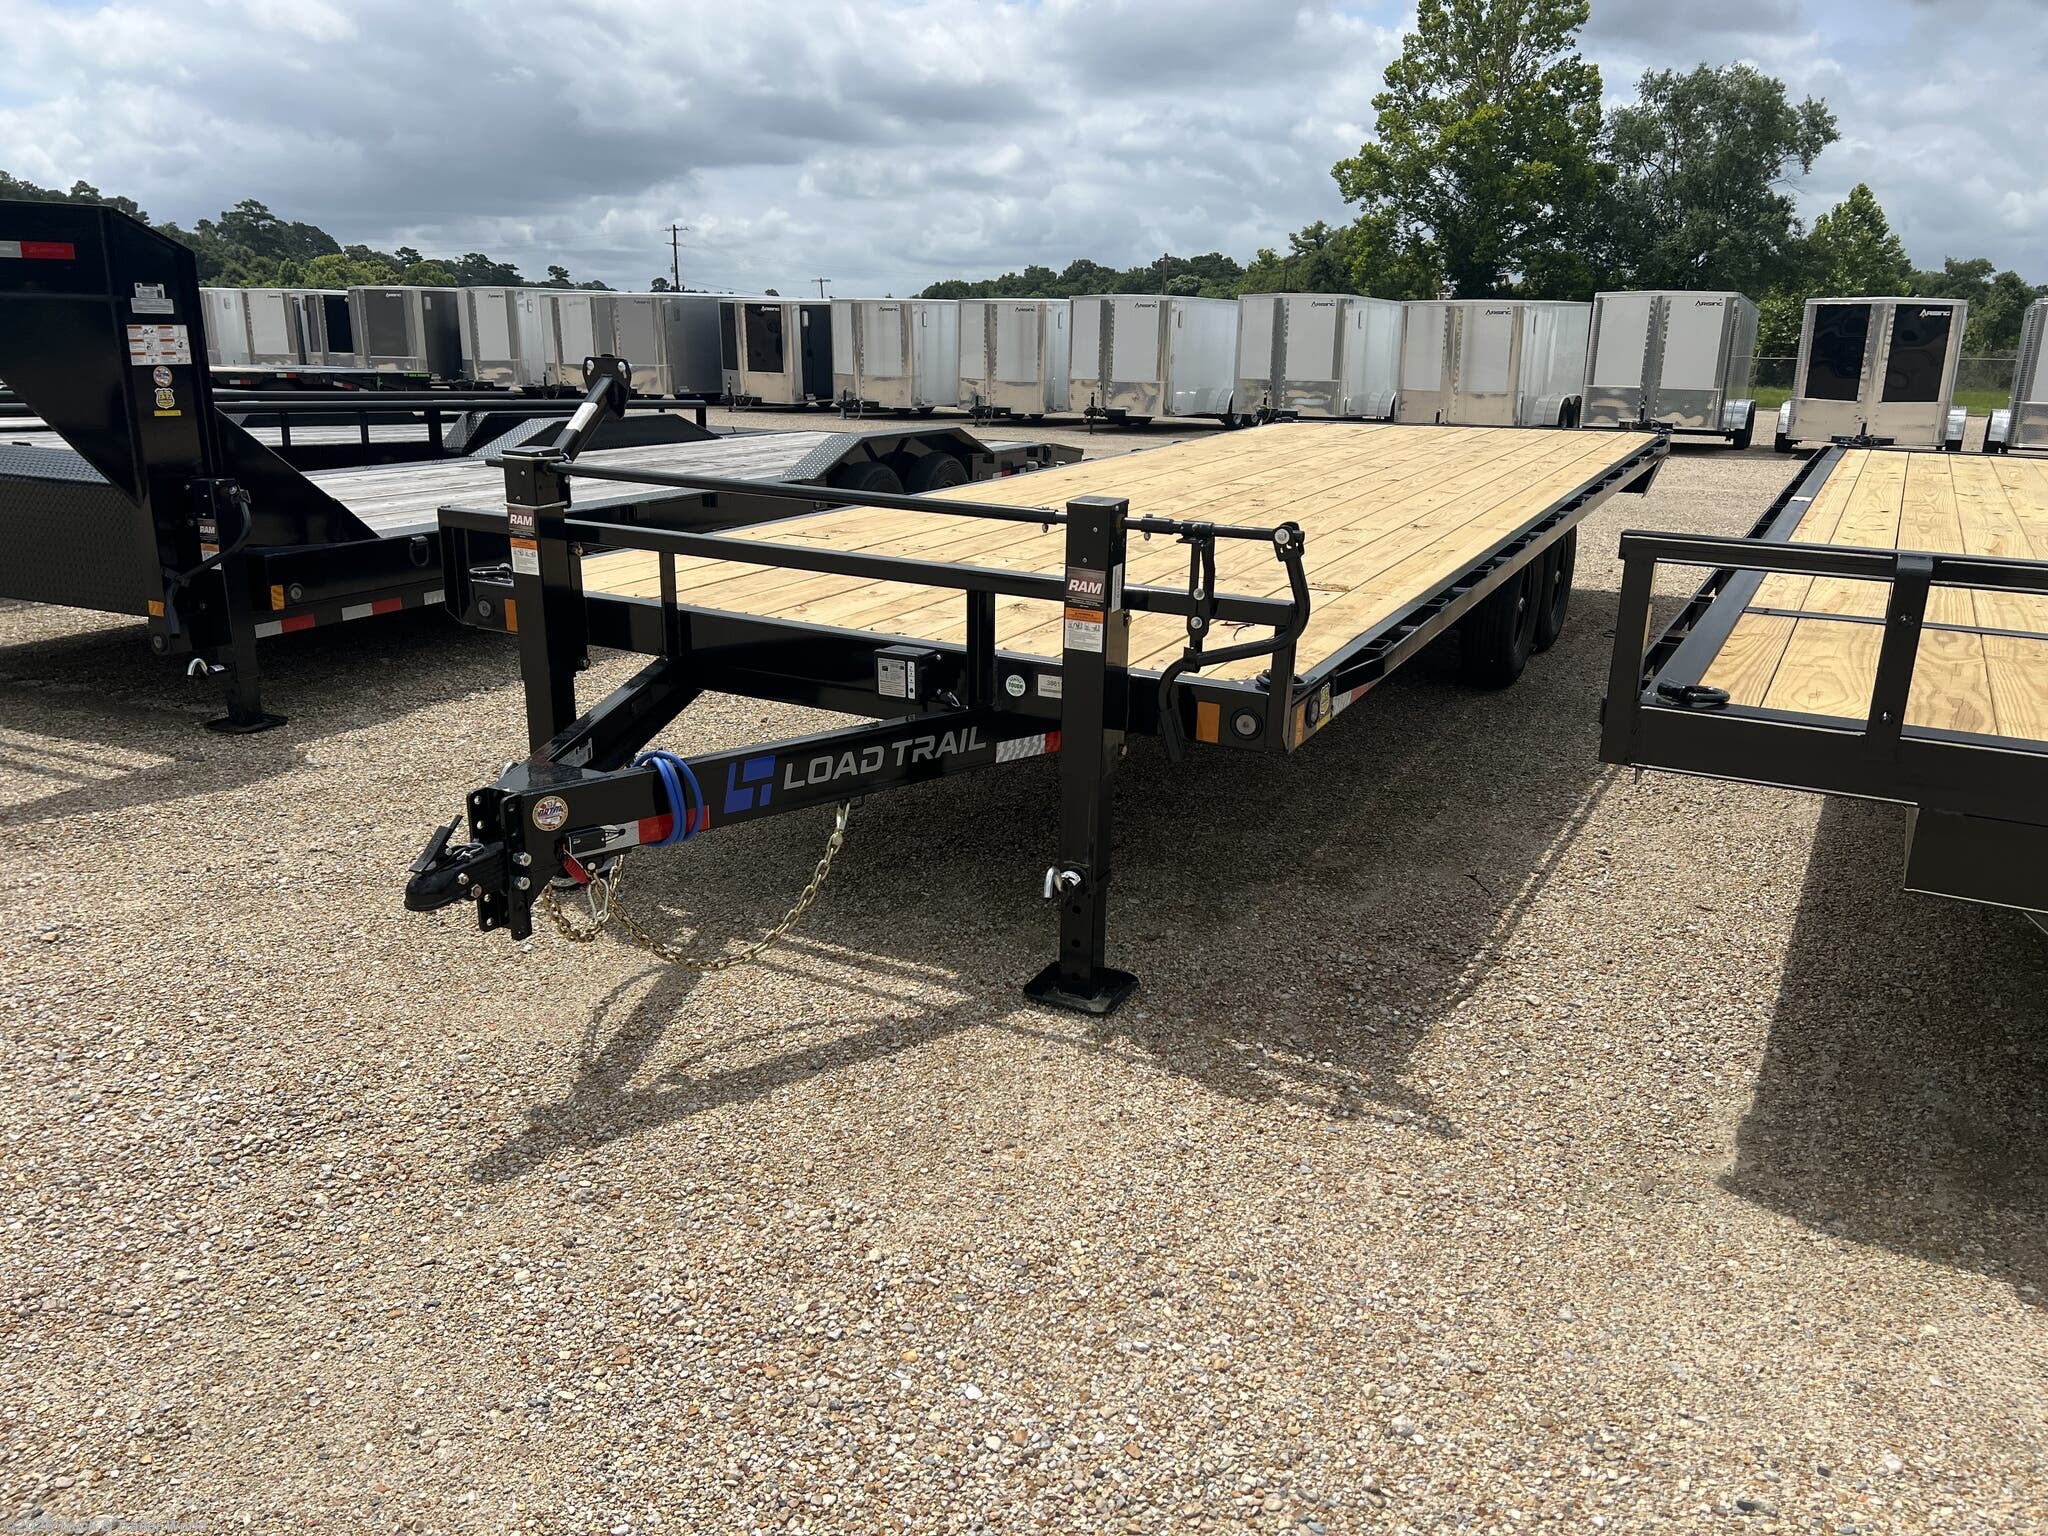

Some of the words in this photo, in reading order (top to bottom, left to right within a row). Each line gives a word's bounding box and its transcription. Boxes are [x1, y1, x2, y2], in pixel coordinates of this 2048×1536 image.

[511, 514, 533, 526] RAM
[200, 525, 216, 534] RAM
[1068, 579, 1103, 595] RAM
[783, 745, 885, 790] LOAD
[891, 726, 987, 766] TRAIL
